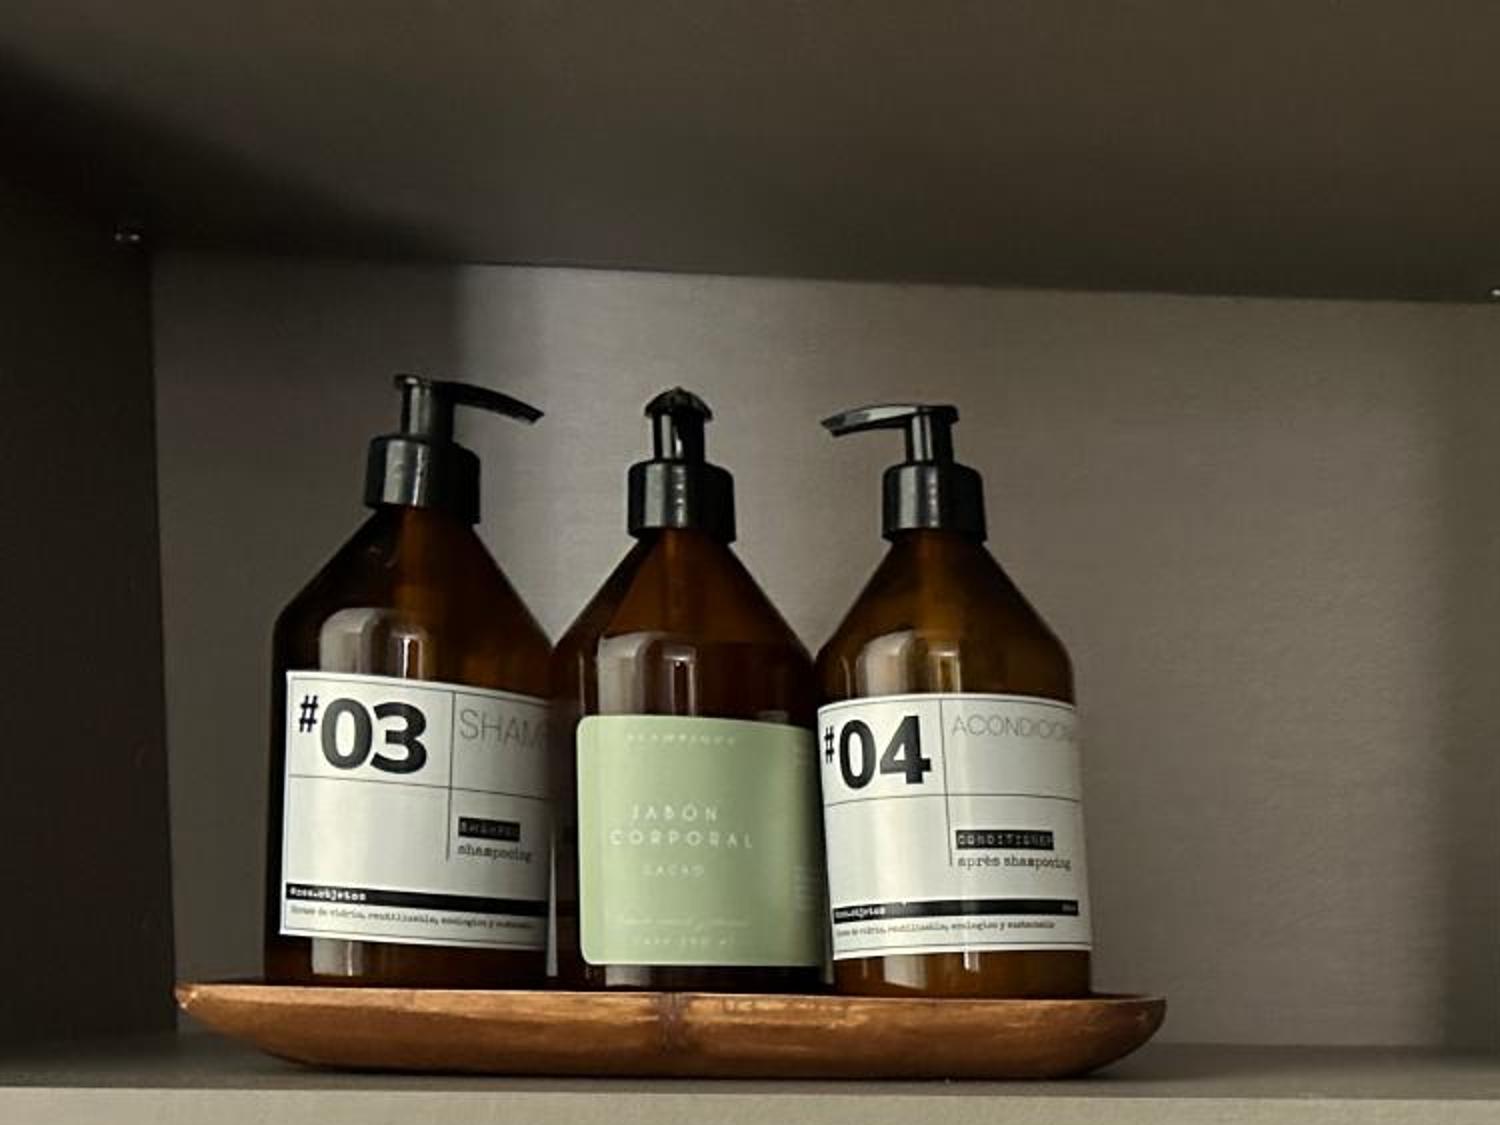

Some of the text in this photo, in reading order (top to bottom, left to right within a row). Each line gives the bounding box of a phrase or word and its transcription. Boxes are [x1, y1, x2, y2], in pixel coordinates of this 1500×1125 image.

[299, 695, 428, 774] #03
[824, 715, 932, 790] #04
[609, 829, 754, 849] CORPORAL
